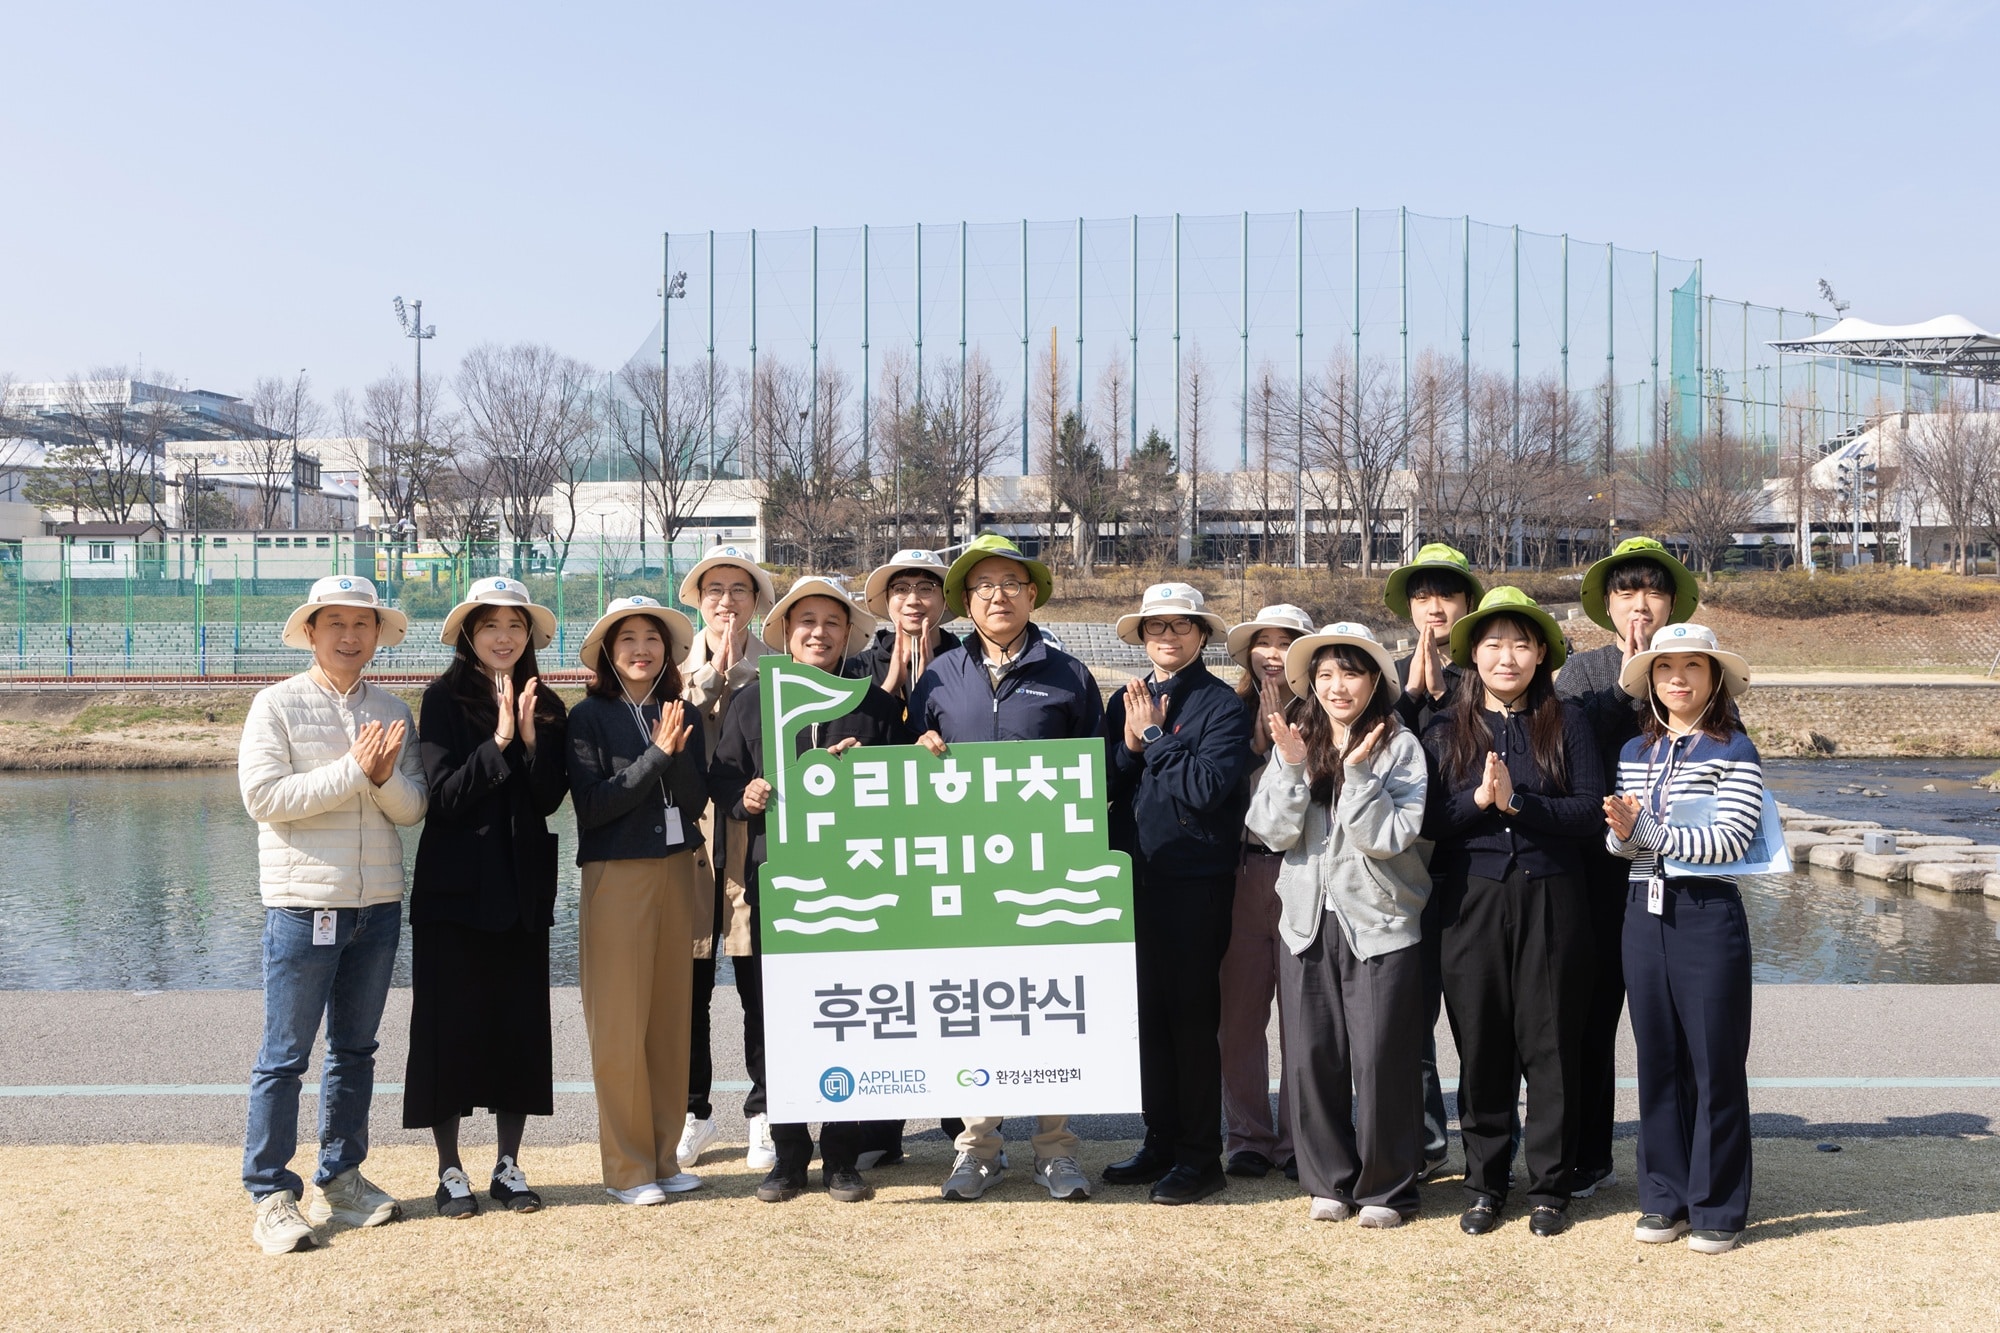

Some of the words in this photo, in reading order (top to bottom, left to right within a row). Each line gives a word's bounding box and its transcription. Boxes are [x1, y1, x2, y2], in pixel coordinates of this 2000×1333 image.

[802, 754, 1095, 844] 우리하천
[845, 832, 1046, 917] 지킴이
[812, 980, 918, 1043] 후원
[928, 975, 1087, 1038] 협약식
[858, 1069, 926, 1084] APPLIED
[858, 1083, 927, 1096] MATERIALS
[995, 1067, 1082, 1087] 환경실천연합회
